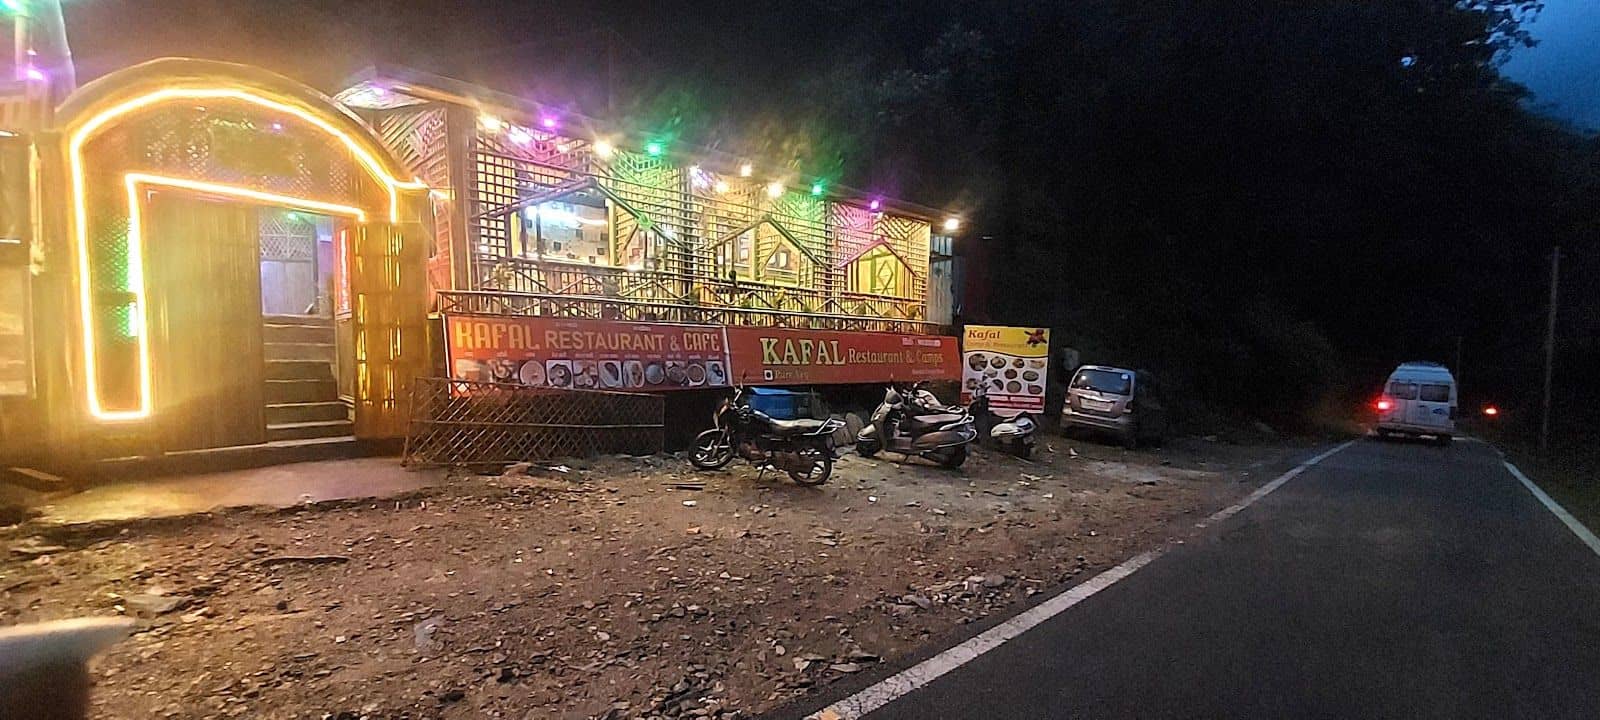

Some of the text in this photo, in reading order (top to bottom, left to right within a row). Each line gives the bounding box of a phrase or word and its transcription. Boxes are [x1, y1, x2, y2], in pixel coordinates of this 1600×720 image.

[455, 321, 720, 351] KAFAL RESTAURANT & CAFE
[968, 328, 1001, 341] Kafal
[759, 337, 846, 365] KAFAL
[848, 347, 904, 364] Restaurant
